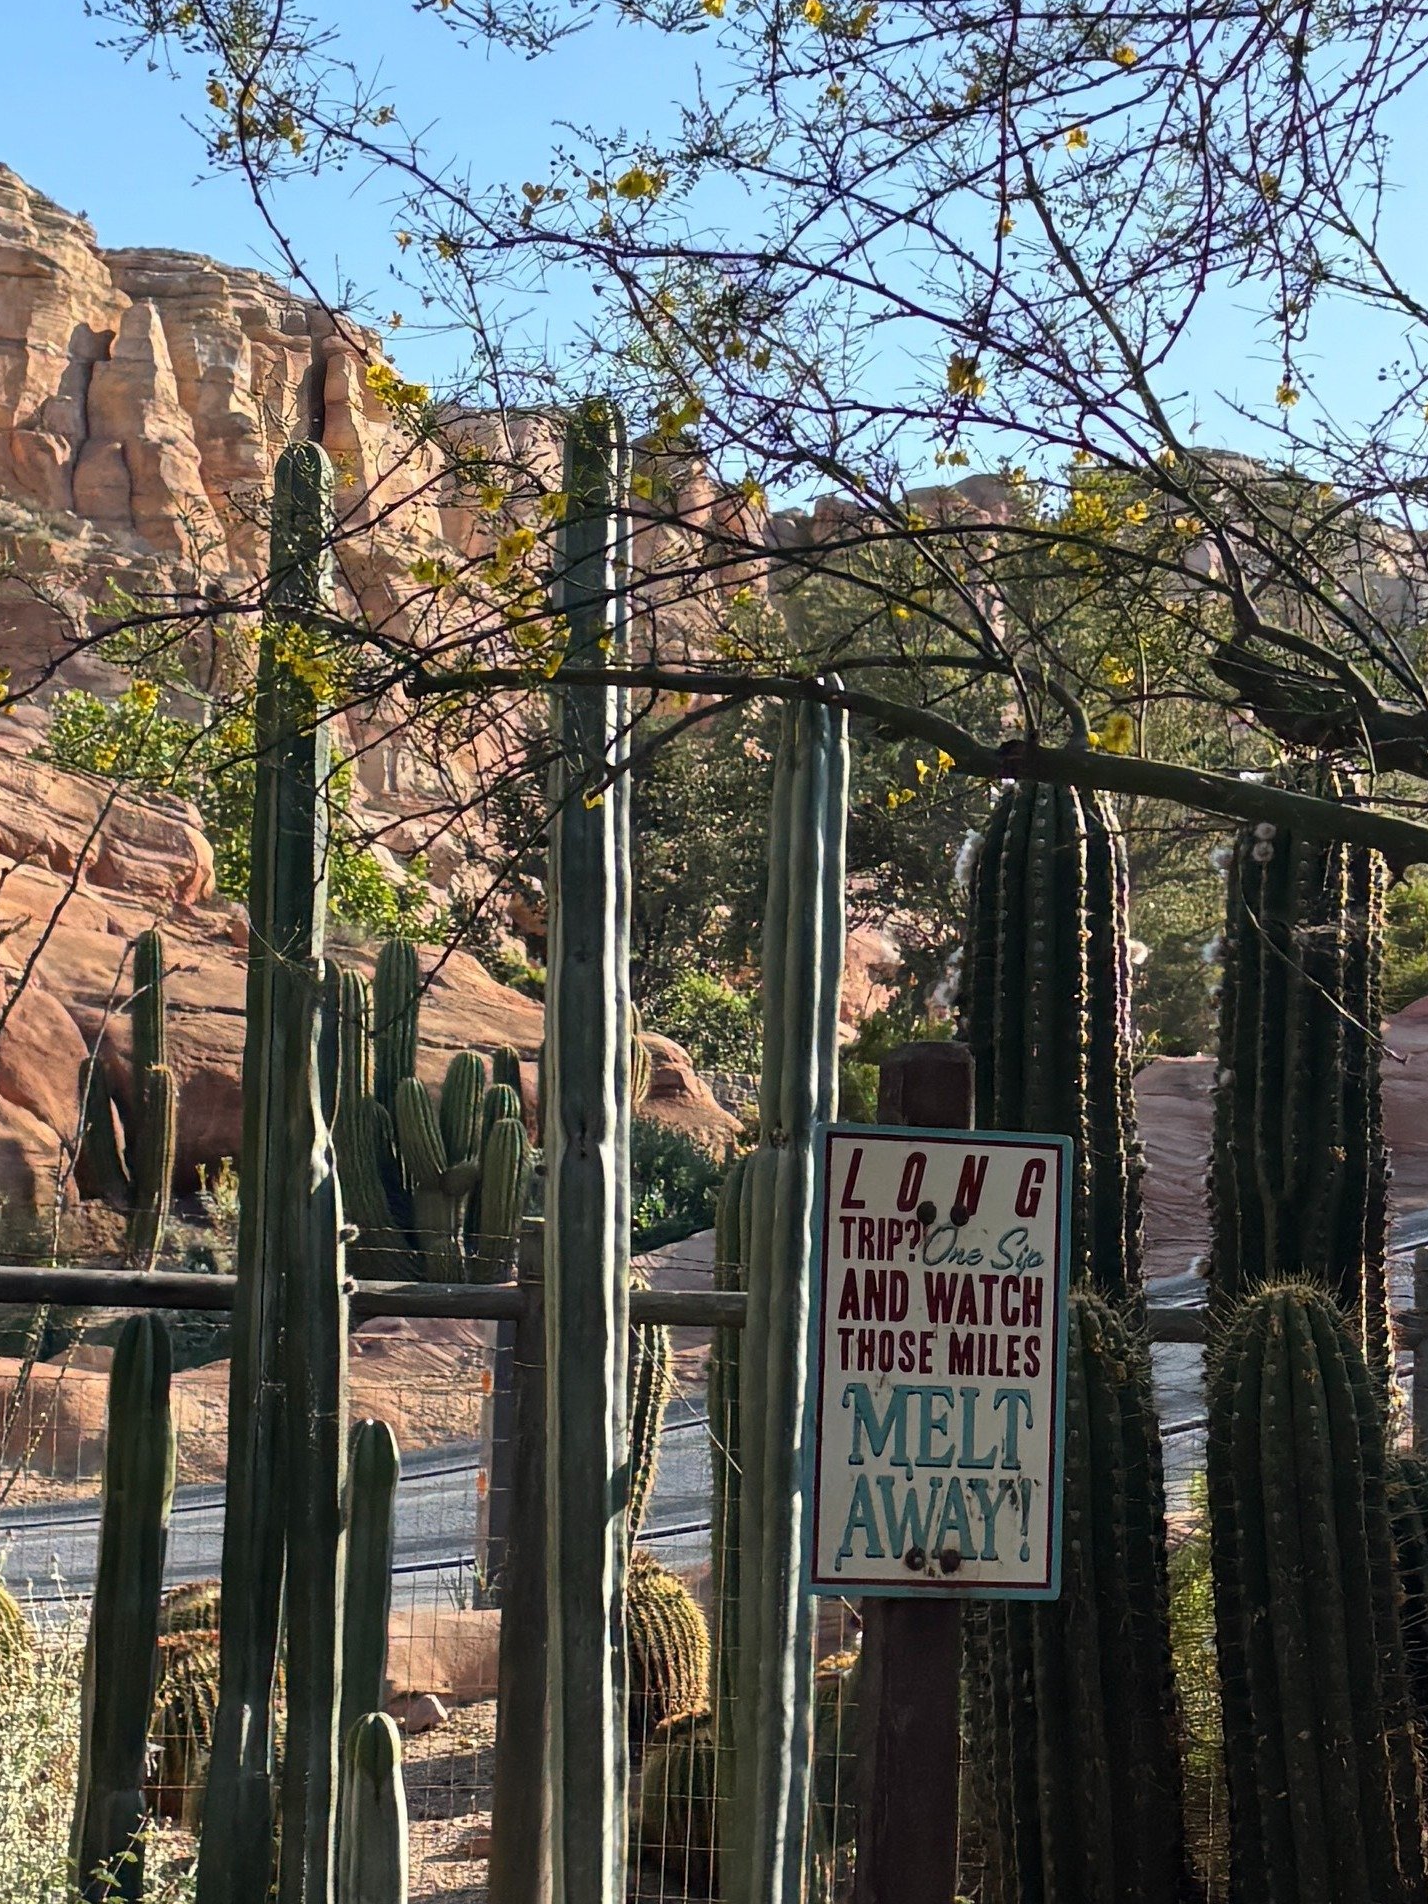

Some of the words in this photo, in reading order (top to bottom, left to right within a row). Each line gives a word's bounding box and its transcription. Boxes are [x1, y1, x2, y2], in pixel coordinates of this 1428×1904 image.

[840, 1148, 1047, 1218] LONG
[839, 1216, 921, 1262] TRIP?
[922, 1226, 984, 1266] One
[990, 1227, 1044, 1276] Sip
[838, 1268, 909, 1322] AND
[924, 1271, 1043, 1327] WATCH
[837, 1327, 936, 1374] THOSE
[948, 1331, 1041, 1378] MILES
[842, 1382, 1033, 1481] MELT
[834, 1473, 1032, 1571] AWAY!
